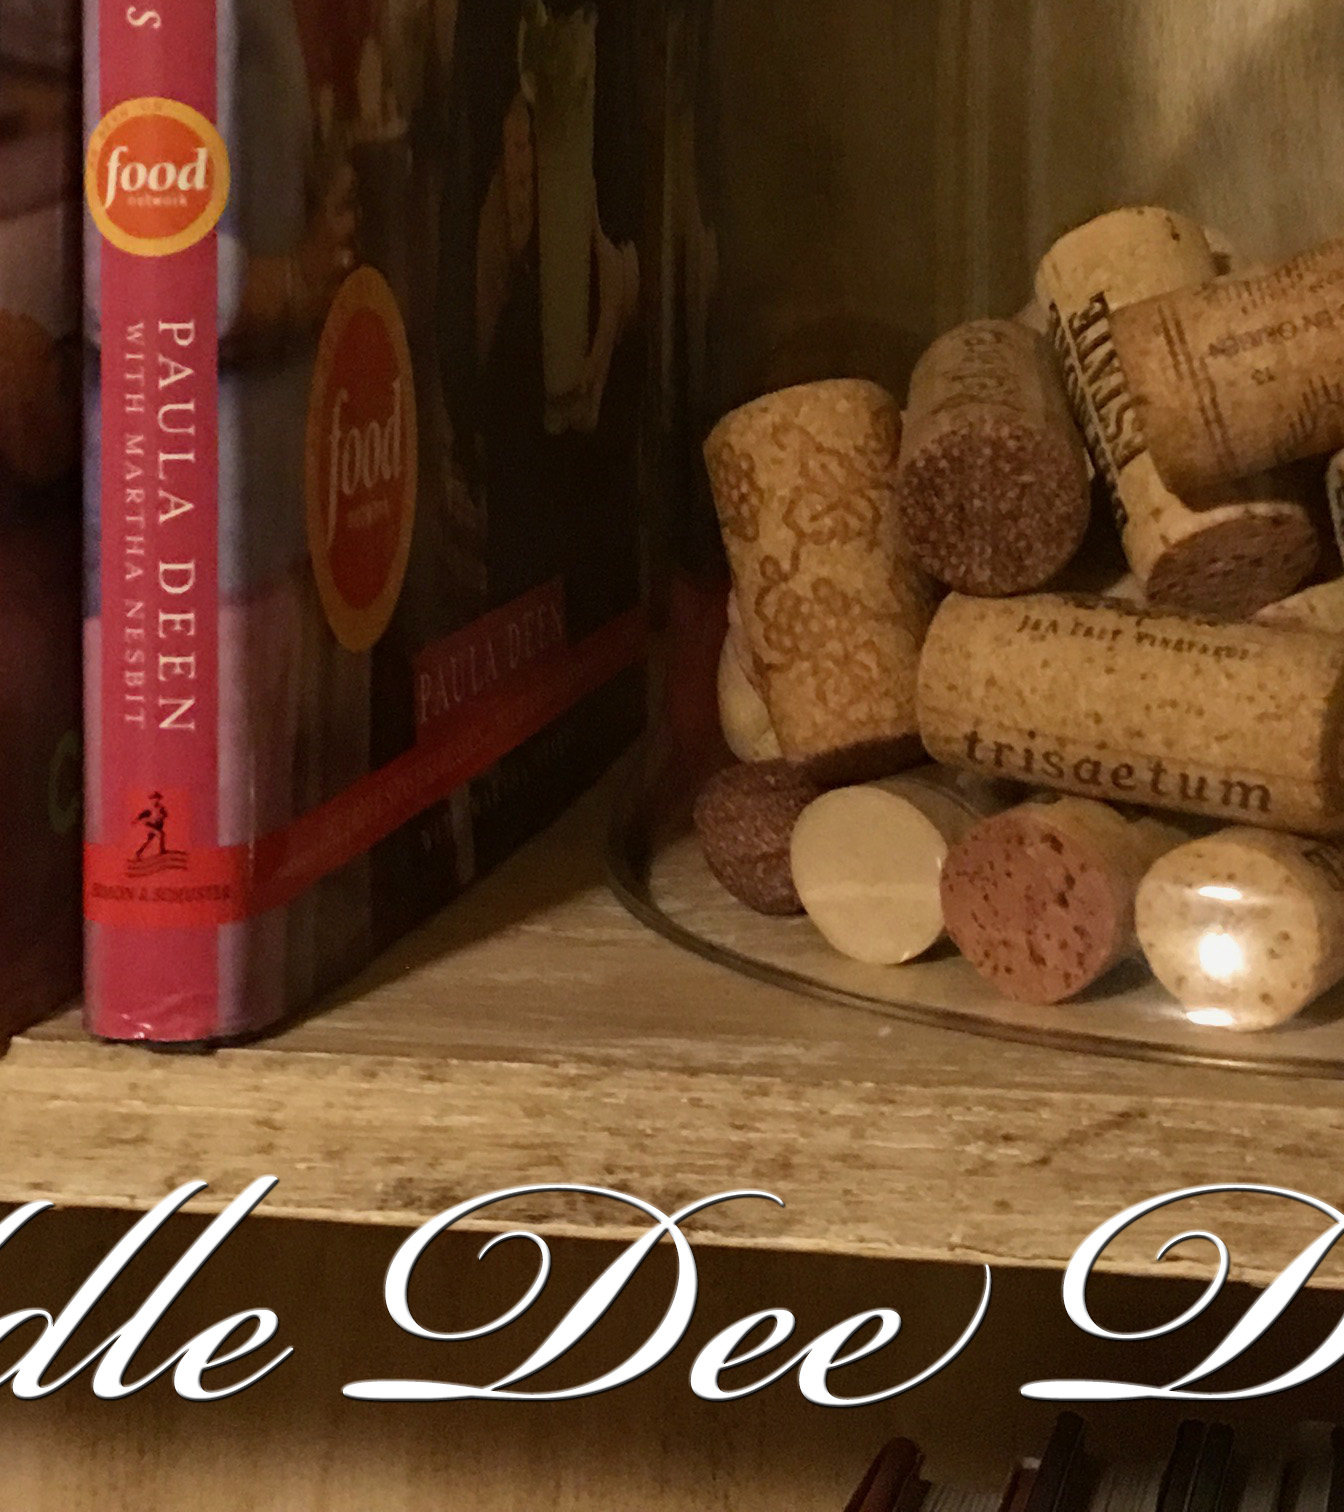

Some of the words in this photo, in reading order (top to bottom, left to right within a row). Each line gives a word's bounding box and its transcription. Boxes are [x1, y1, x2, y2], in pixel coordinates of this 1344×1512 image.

[102, 145, 208, 210] food
[124, 323, 145, 413] WITH
[157, 318, 197, 524] PAULA
[124, 430, 145, 582] MARTHA
[326, 377, 402, 550] food
[124, 601, 145, 728] NESBIT
[157, 558, 197, 733] DEEN
[964, 728, 1274, 817] trisaetum
